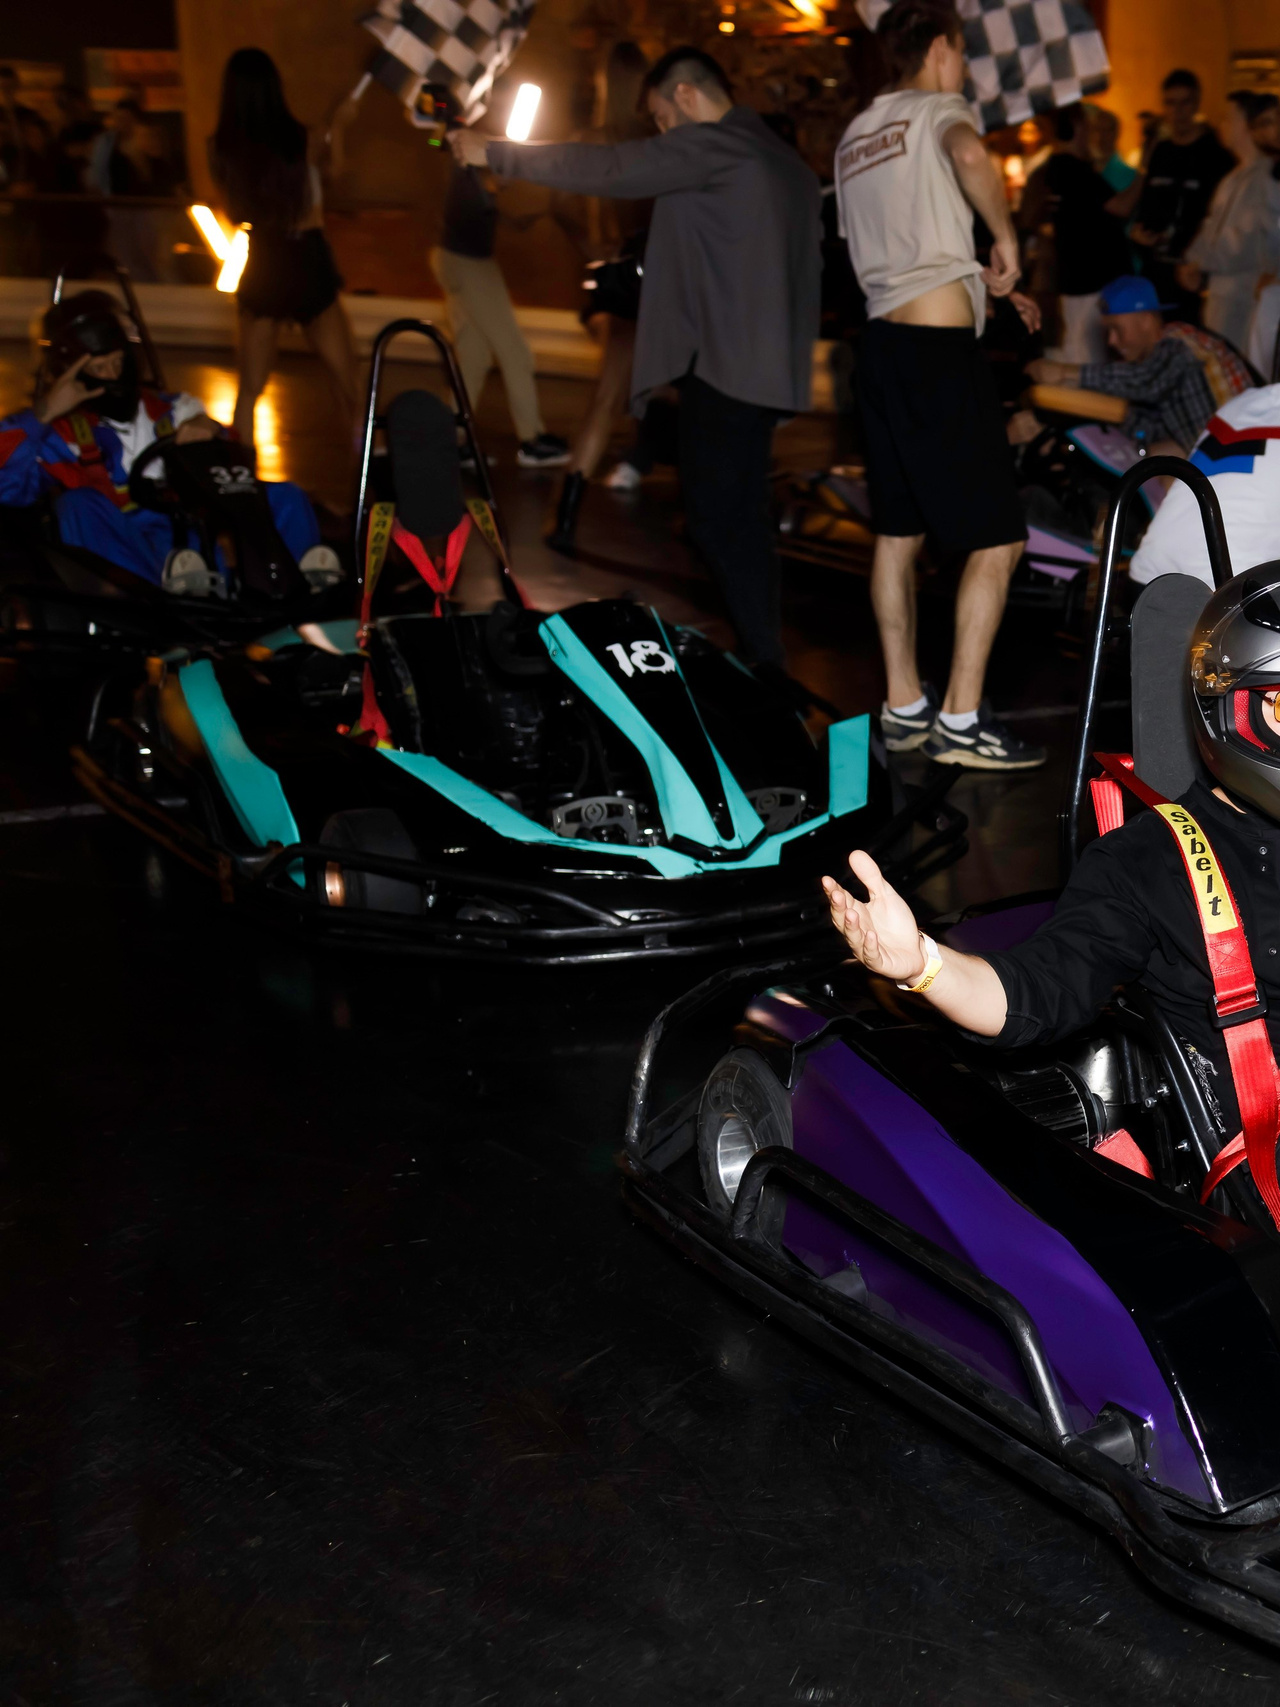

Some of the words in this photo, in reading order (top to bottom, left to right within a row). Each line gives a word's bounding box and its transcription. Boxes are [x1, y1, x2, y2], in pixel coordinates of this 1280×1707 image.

[209, 465, 256, 485] 32
[605, 640, 676, 678] 18
[1170, 811, 1222, 916] Sabelt
